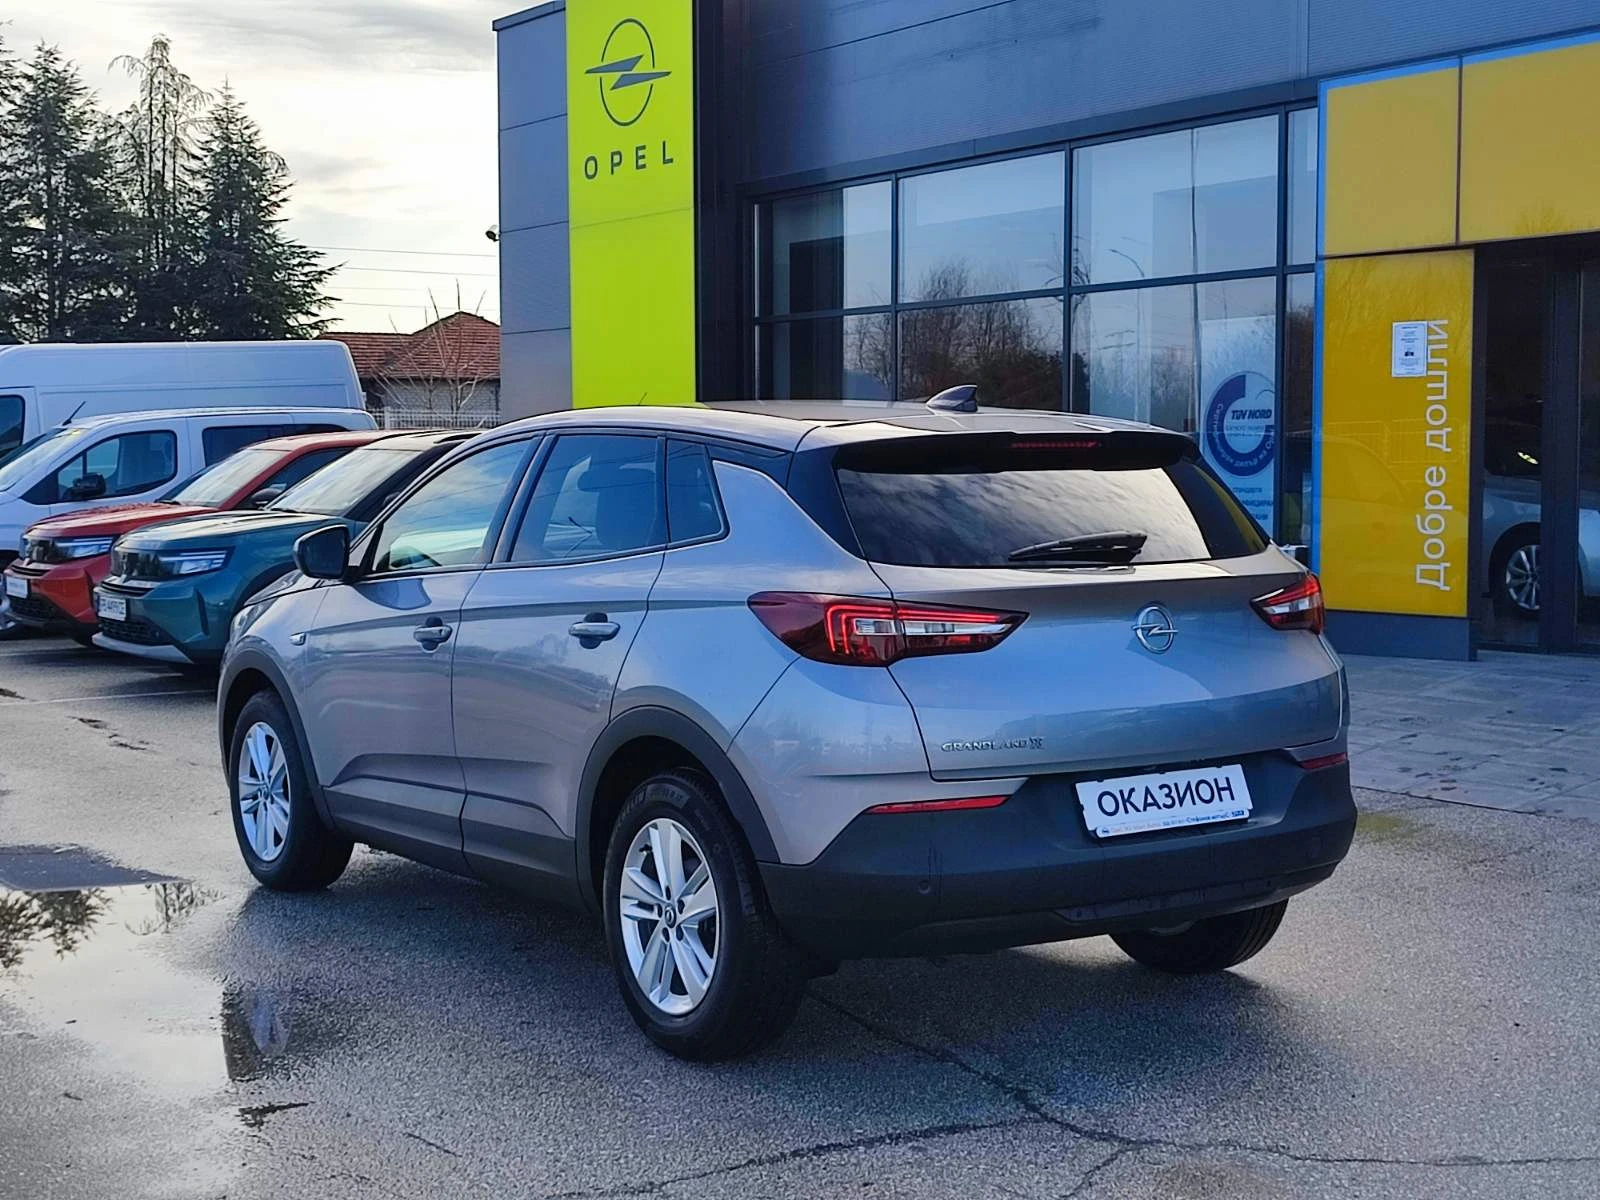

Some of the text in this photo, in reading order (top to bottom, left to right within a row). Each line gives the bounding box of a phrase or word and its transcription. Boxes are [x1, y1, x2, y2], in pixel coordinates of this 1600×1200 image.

[584, 140, 674, 180] OPEL
[1248, 408, 1273, 420] NORD
[1416, 319, 1452, 591] Добре дошли
[941, 738, 1027, 753] GRANDLAND
[1097, 776, 1236, 817] ОКАЗИОН
